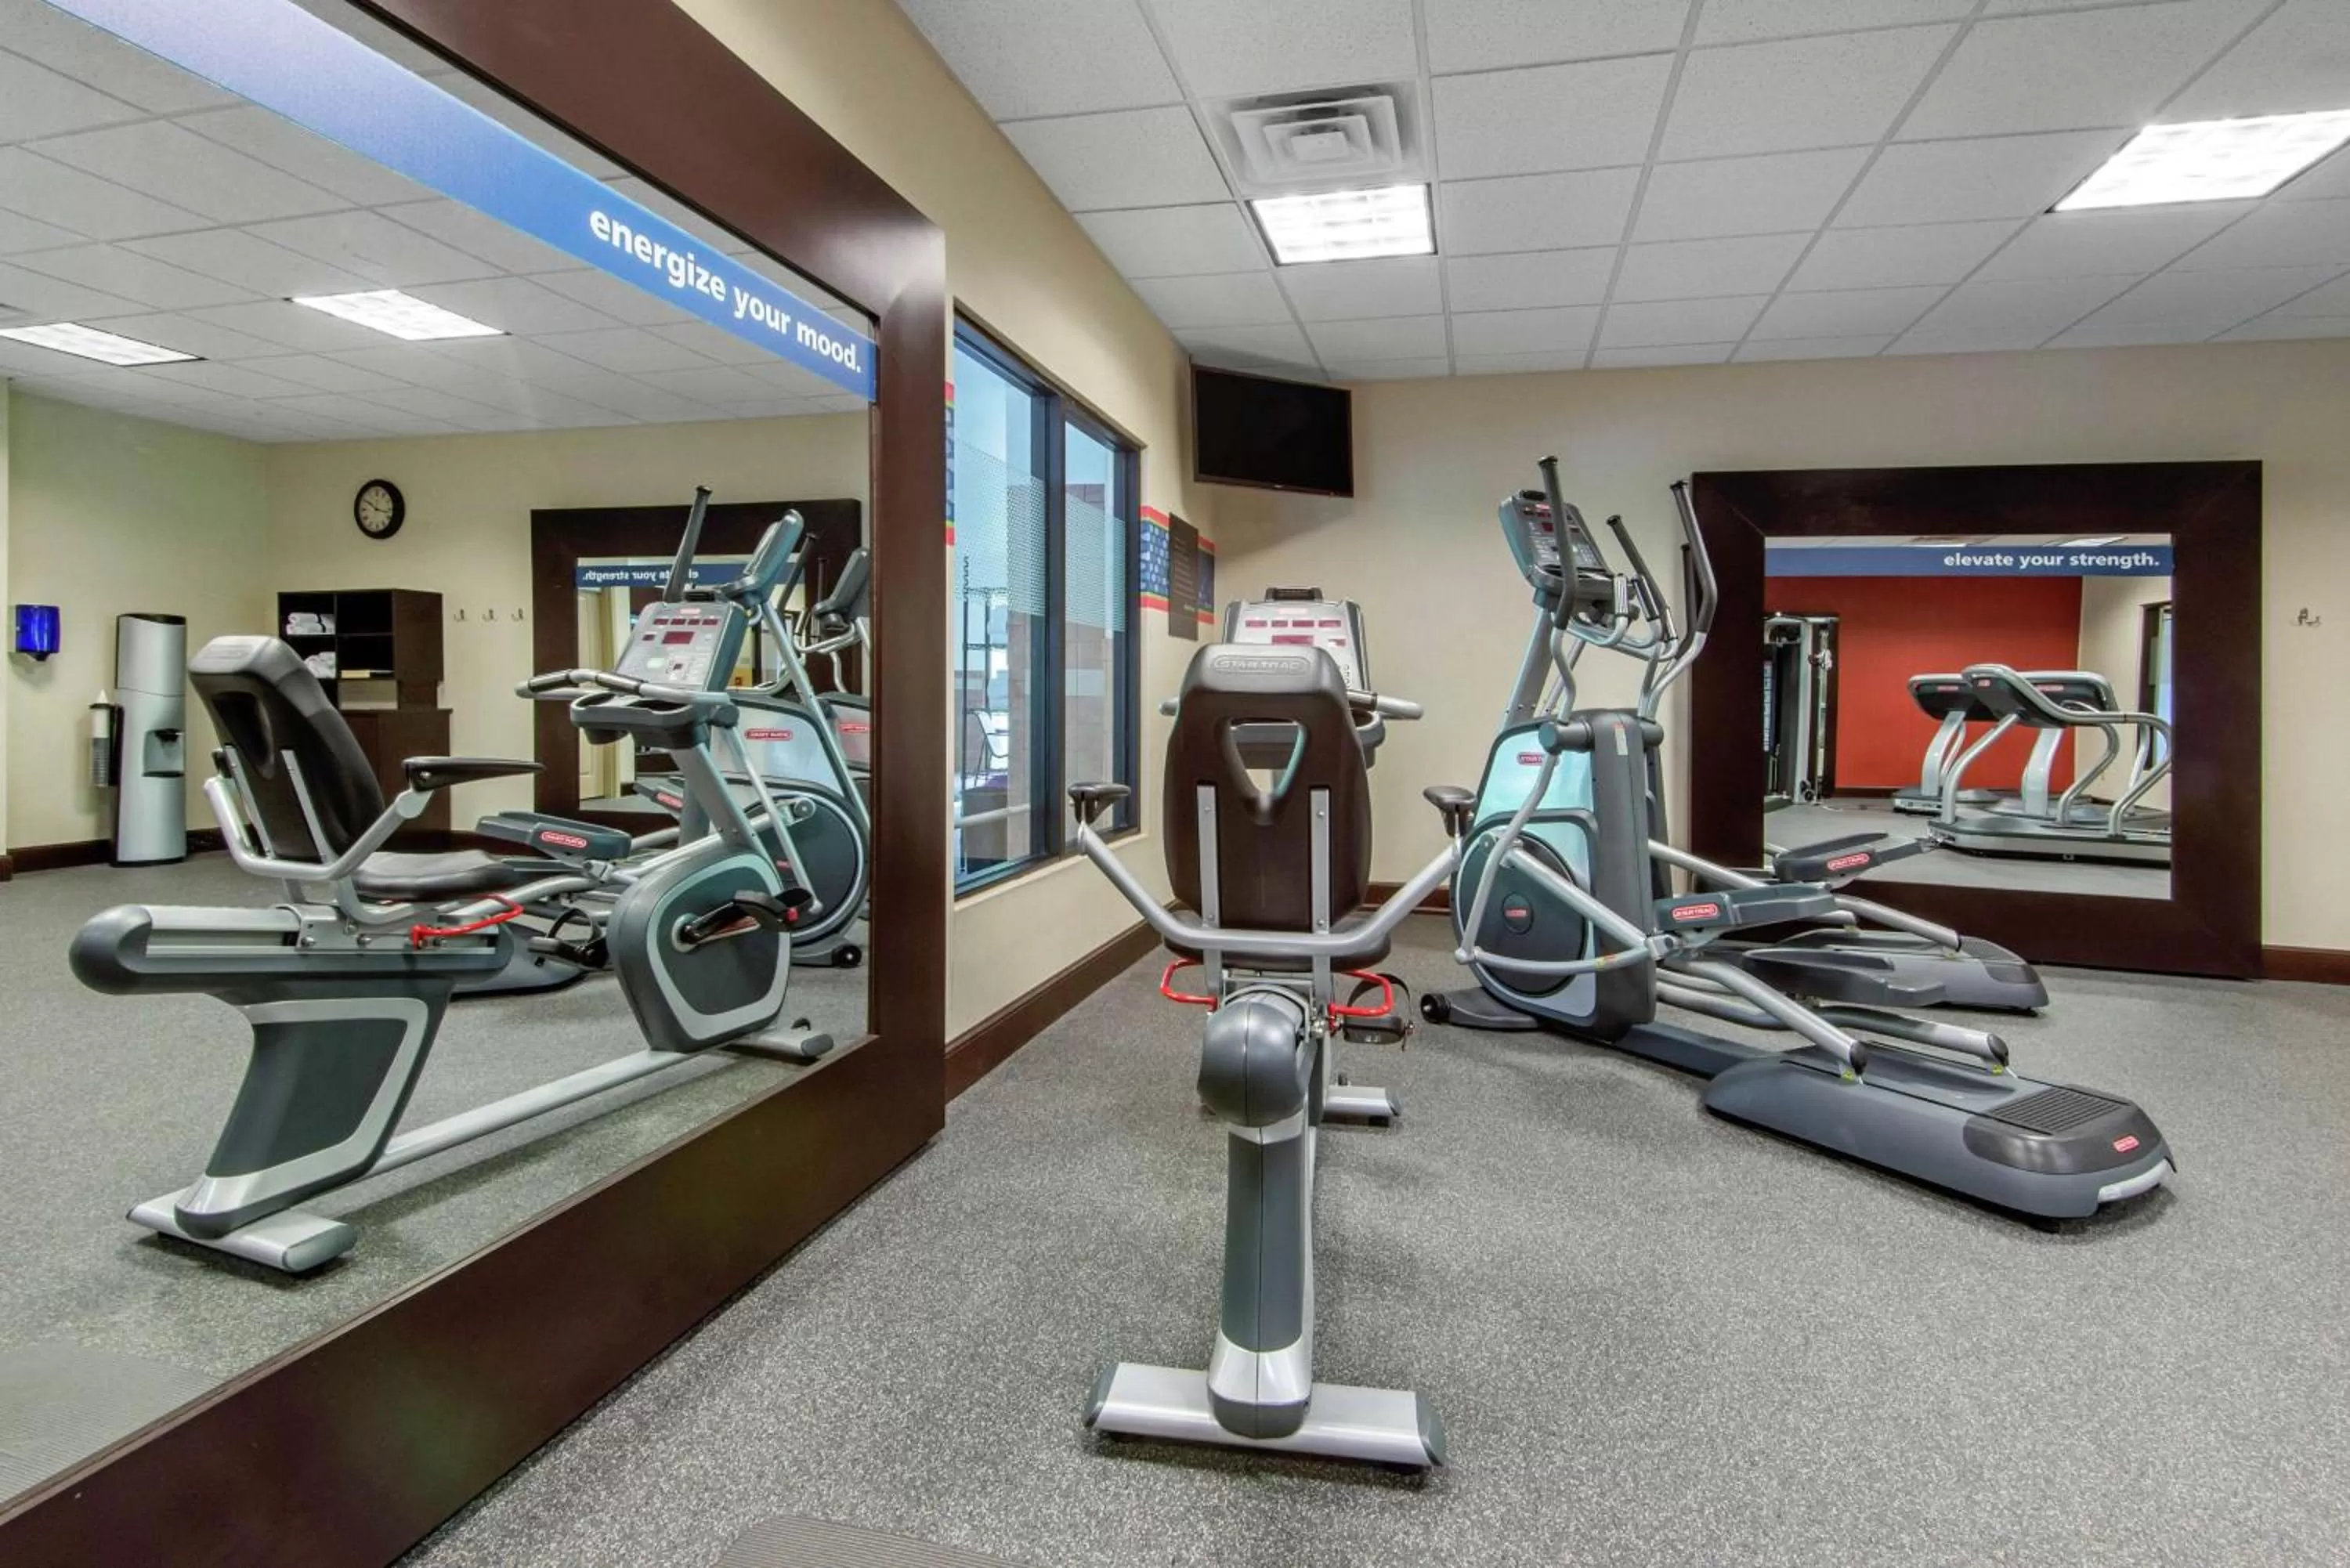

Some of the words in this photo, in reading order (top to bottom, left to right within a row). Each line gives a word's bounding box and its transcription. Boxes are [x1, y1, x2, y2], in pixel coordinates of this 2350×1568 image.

[589, 209, 727, 302] energize
[732, 285, 791, 335] your
[796, 320, 862, 373] mood.
[1943, 553, 2014, 566] elevate
[2019, 555, 2064, 569] your
[2069, 553, 2160, 569] strength.
